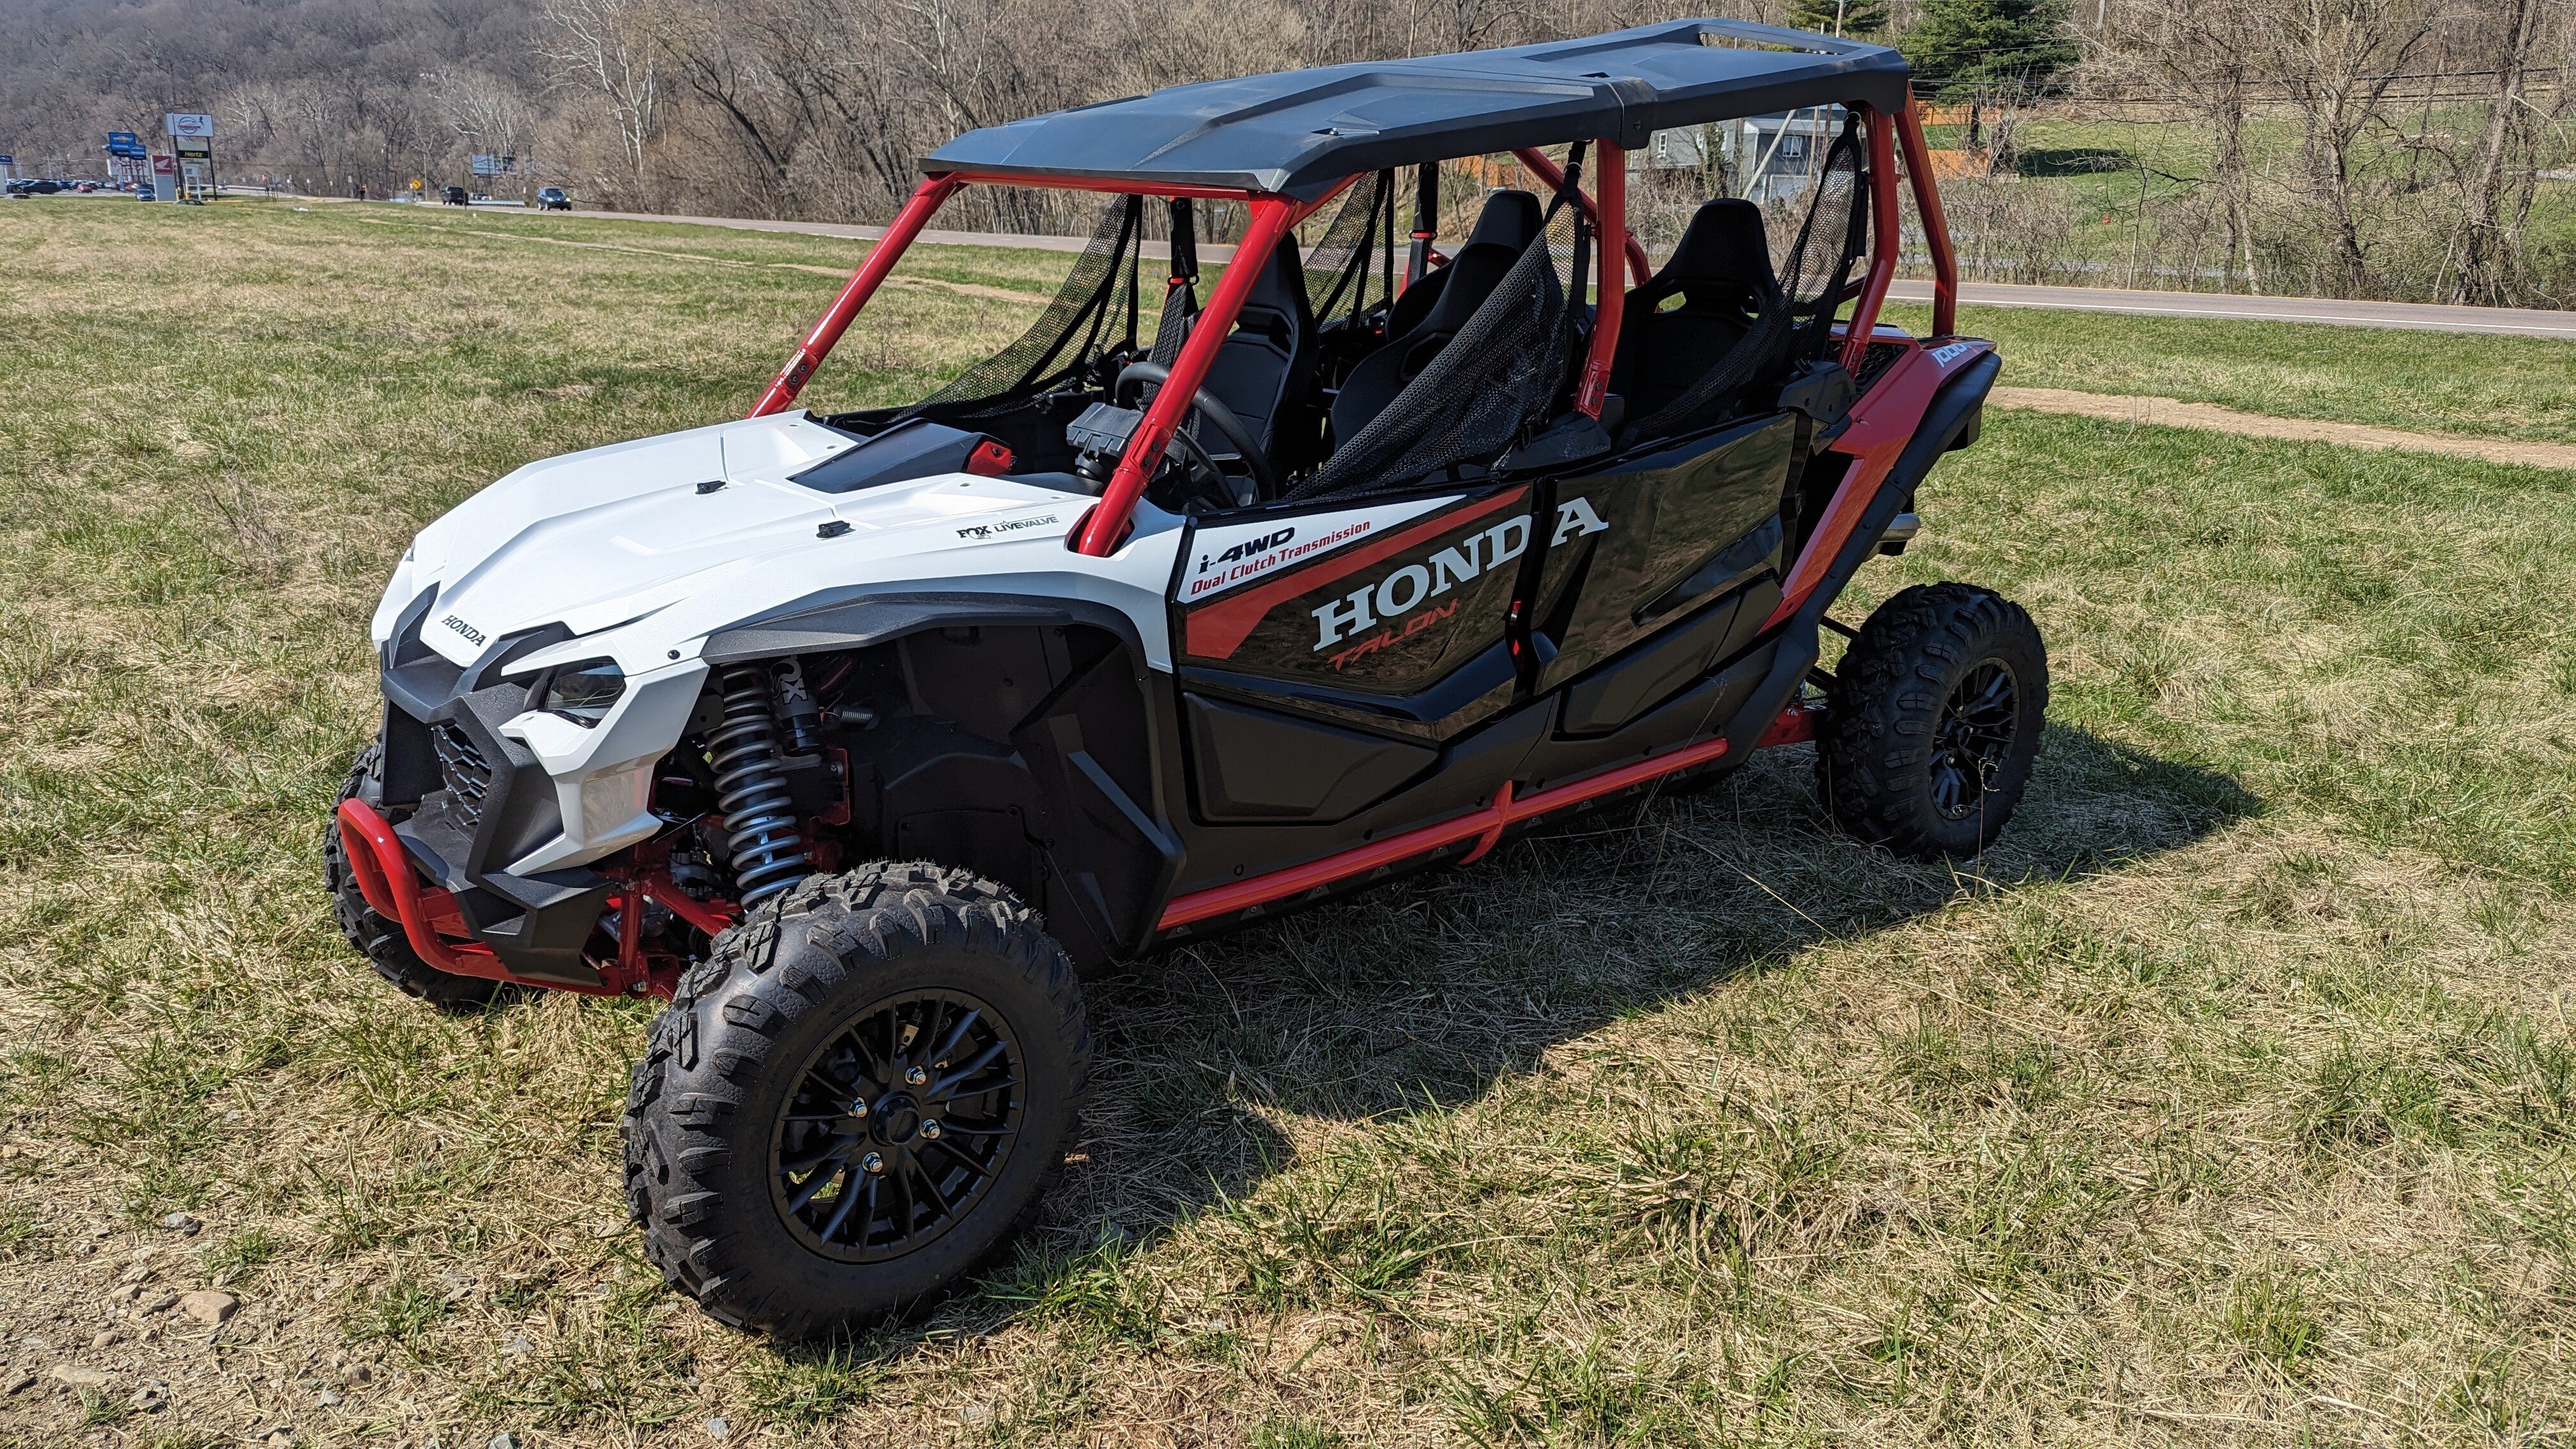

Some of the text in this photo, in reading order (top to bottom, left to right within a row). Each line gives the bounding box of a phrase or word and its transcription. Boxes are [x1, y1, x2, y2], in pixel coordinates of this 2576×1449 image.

[1931, 343, 1967, 368] 1000
[956, 525, 992, 539] FOX
[1198, 526, 1296, 574] i-4WD
[1190, 521, 1370, 595] Dual Clutch Transmission
[1311, 496, 1609, 652] HONDA
[441, 615, 487, 647] HONDA
[1329, 598, 1459, 671] TALON
[770, 656, 808, 704] OX
